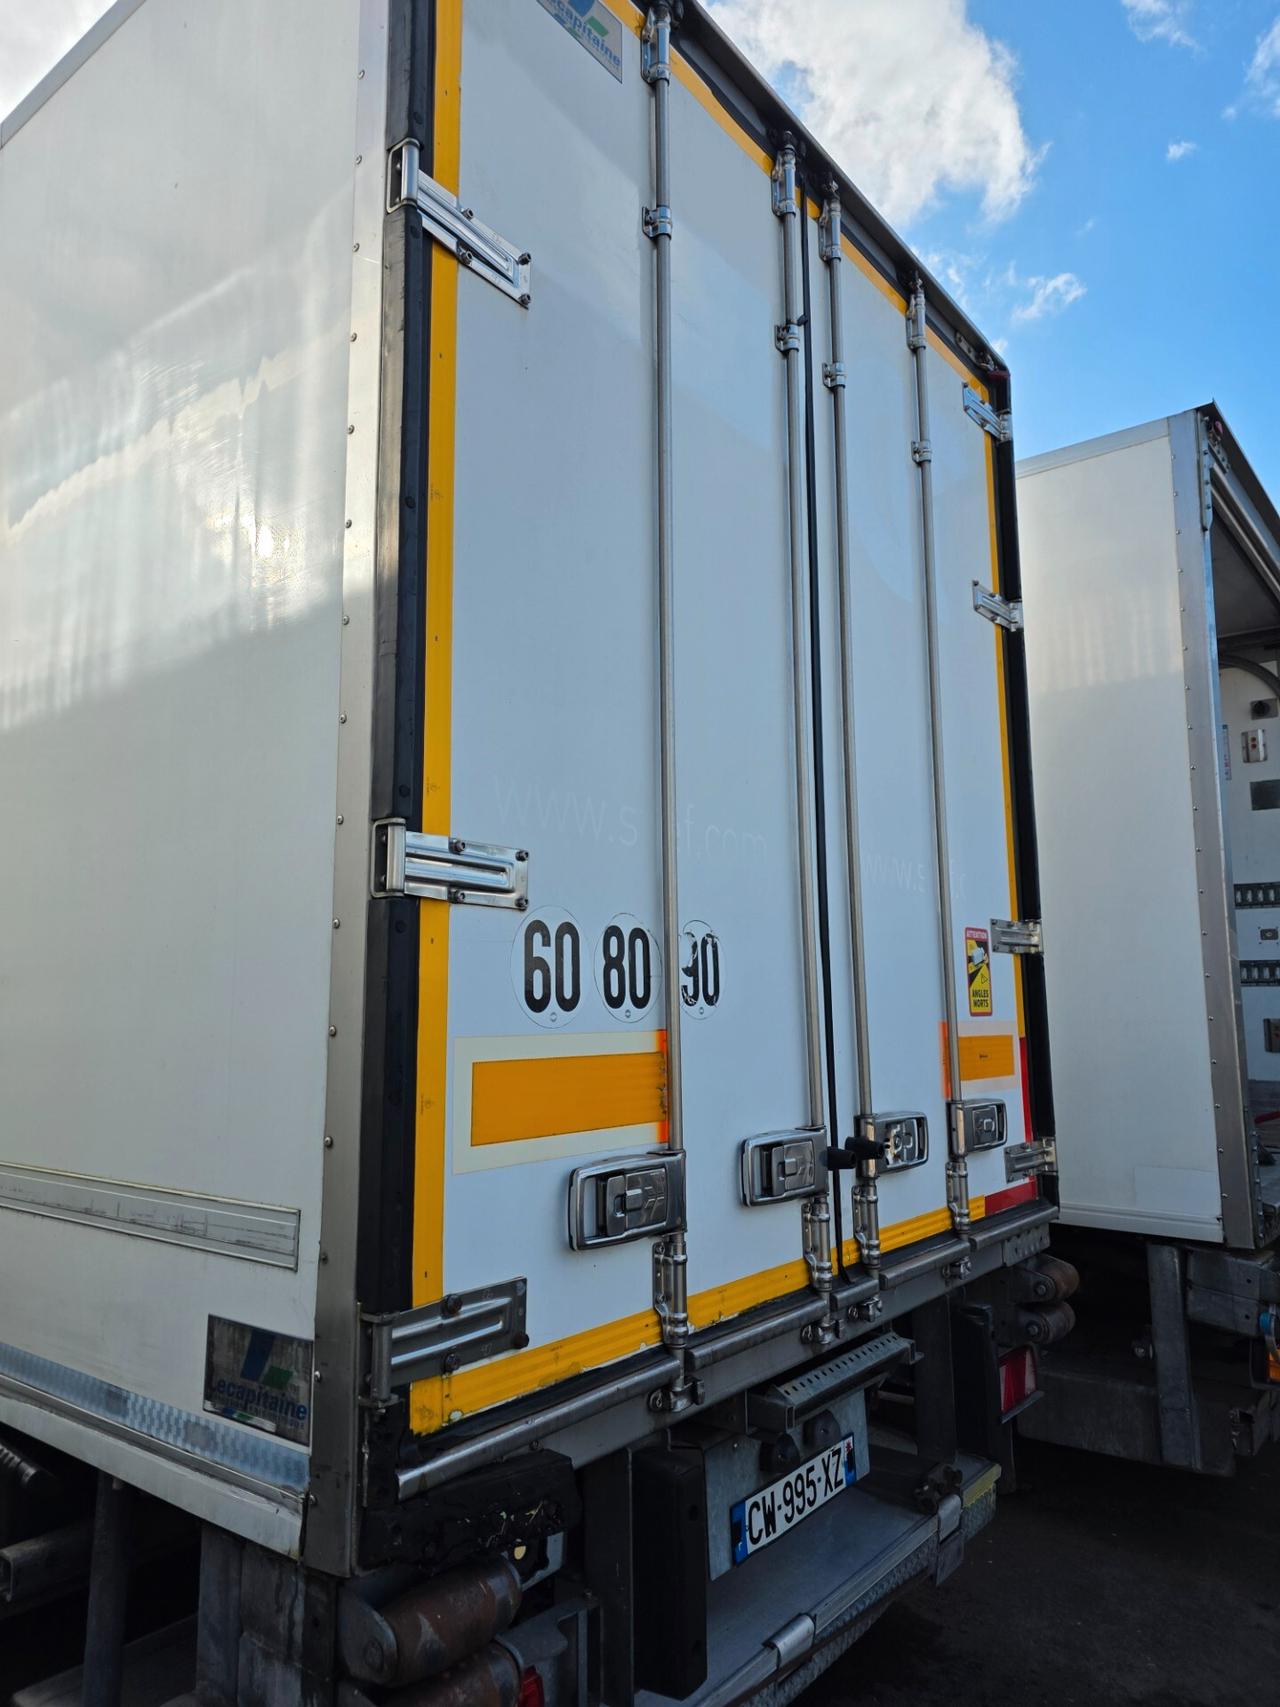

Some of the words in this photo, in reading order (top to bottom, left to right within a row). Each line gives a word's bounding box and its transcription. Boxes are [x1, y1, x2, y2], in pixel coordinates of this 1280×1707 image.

[525, 920, 580, 1013] 60
[603, 925, 650, 1009] 80
[748, 1447, 844, 1546] CW-995-XZ
